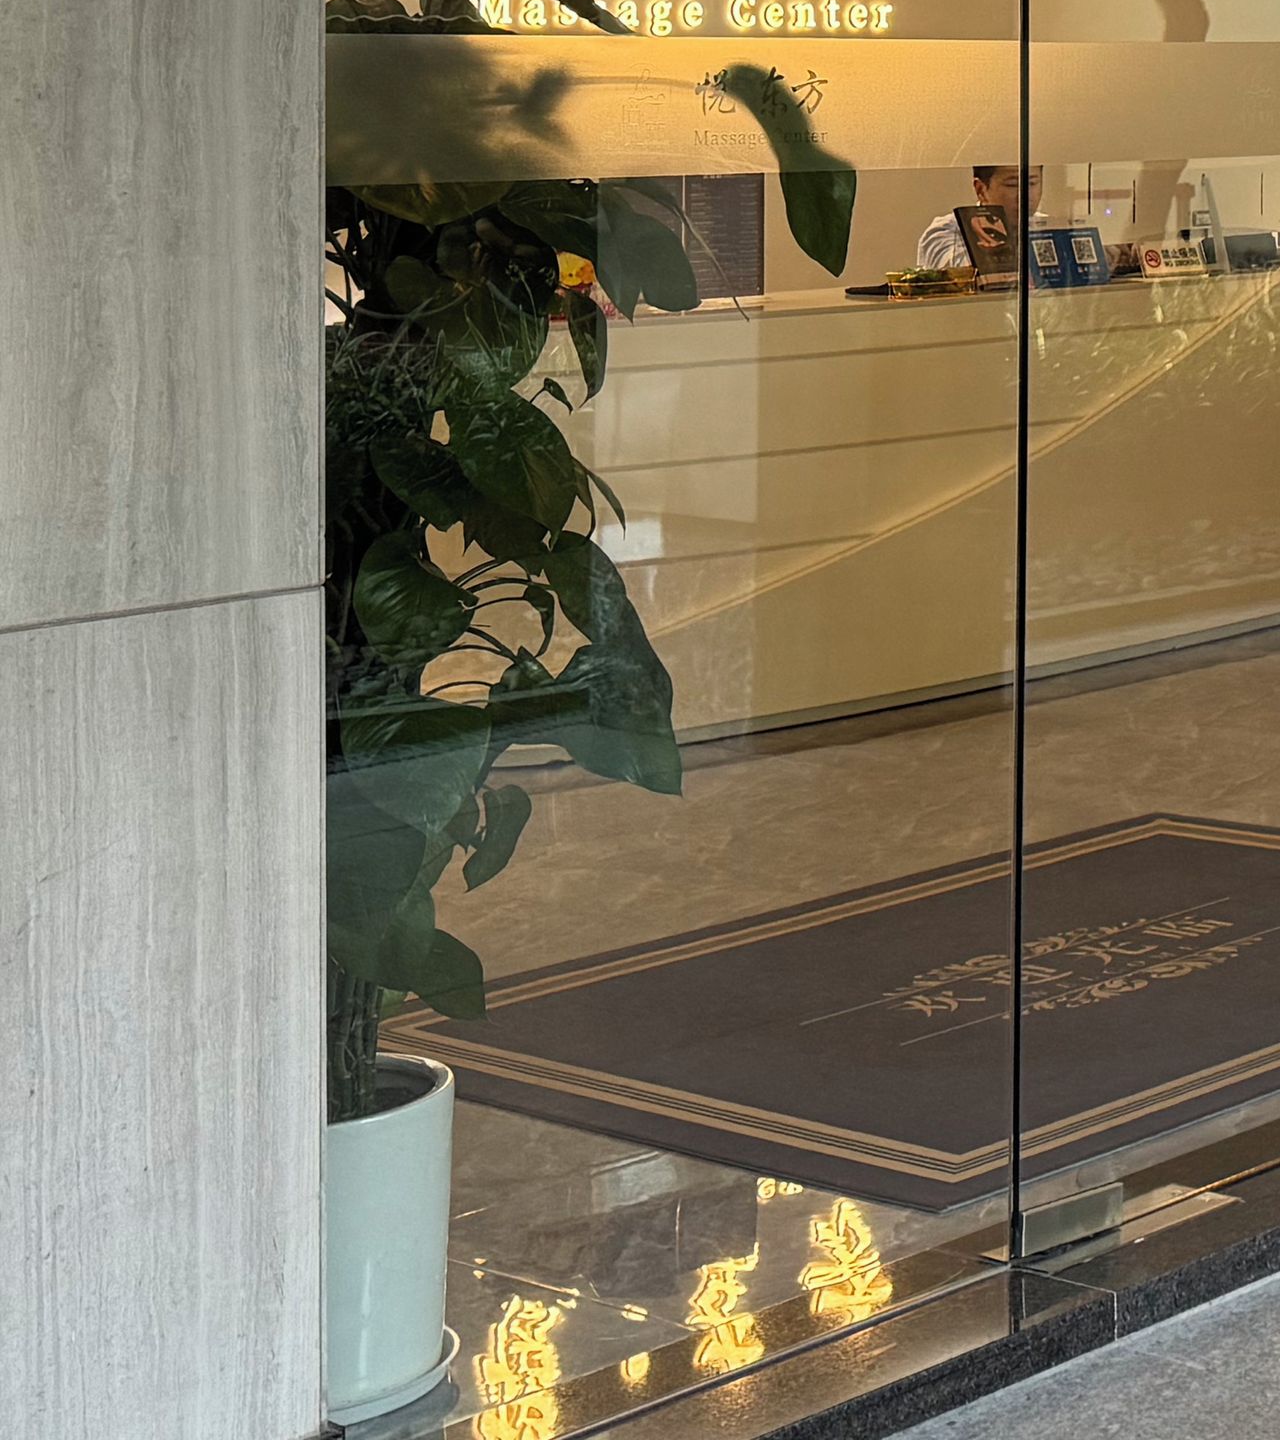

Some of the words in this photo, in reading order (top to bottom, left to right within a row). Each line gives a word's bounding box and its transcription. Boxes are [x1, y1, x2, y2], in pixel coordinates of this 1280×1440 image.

[694, 65, 829, 116] 悦东方
[694, 129, 769, 148] Massage
